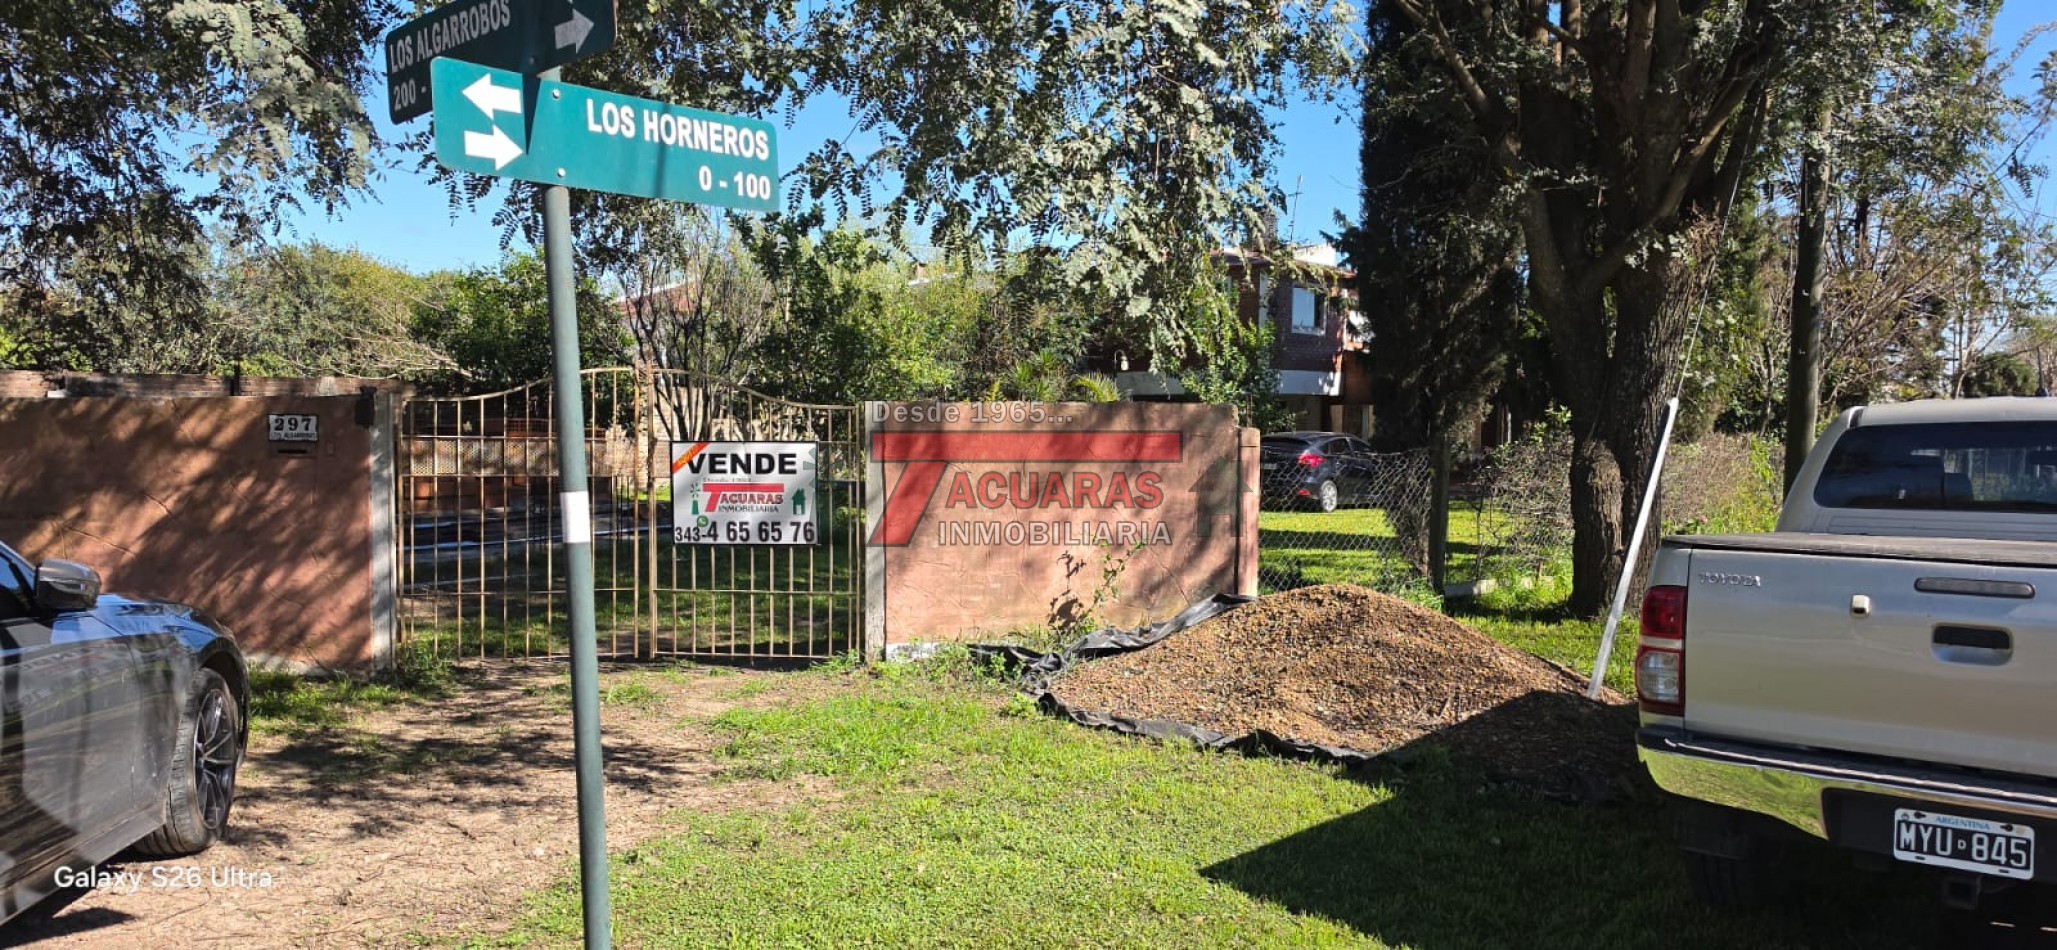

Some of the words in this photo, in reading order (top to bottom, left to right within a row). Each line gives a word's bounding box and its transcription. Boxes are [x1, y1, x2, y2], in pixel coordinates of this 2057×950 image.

[389, 35, 414, 74] LOS
[416, 0, 511, 63] ALGARROBOS
[393, 77, 417, 112] 200
[586, 97, 636, 139] LOS
[643, 109, 770, 161] HORNEROS
[698, 165, 713, 192] 0
[733, 174, 771, 200] 100
[274, 417, 312, 432] 297
[687, 453, 798, 475] VENDE
[702, 483, 785, 512] TACUARAS
[726, 521, 750, 542] 65
[758, 521, 783, 542] 65
[790, 521, 815, 543] 76
[1935, 815, 1991, 831] ARGENTINA
[1899, 822, 1953, 857] MYU
[1971, 832, 2028, 868] 845
